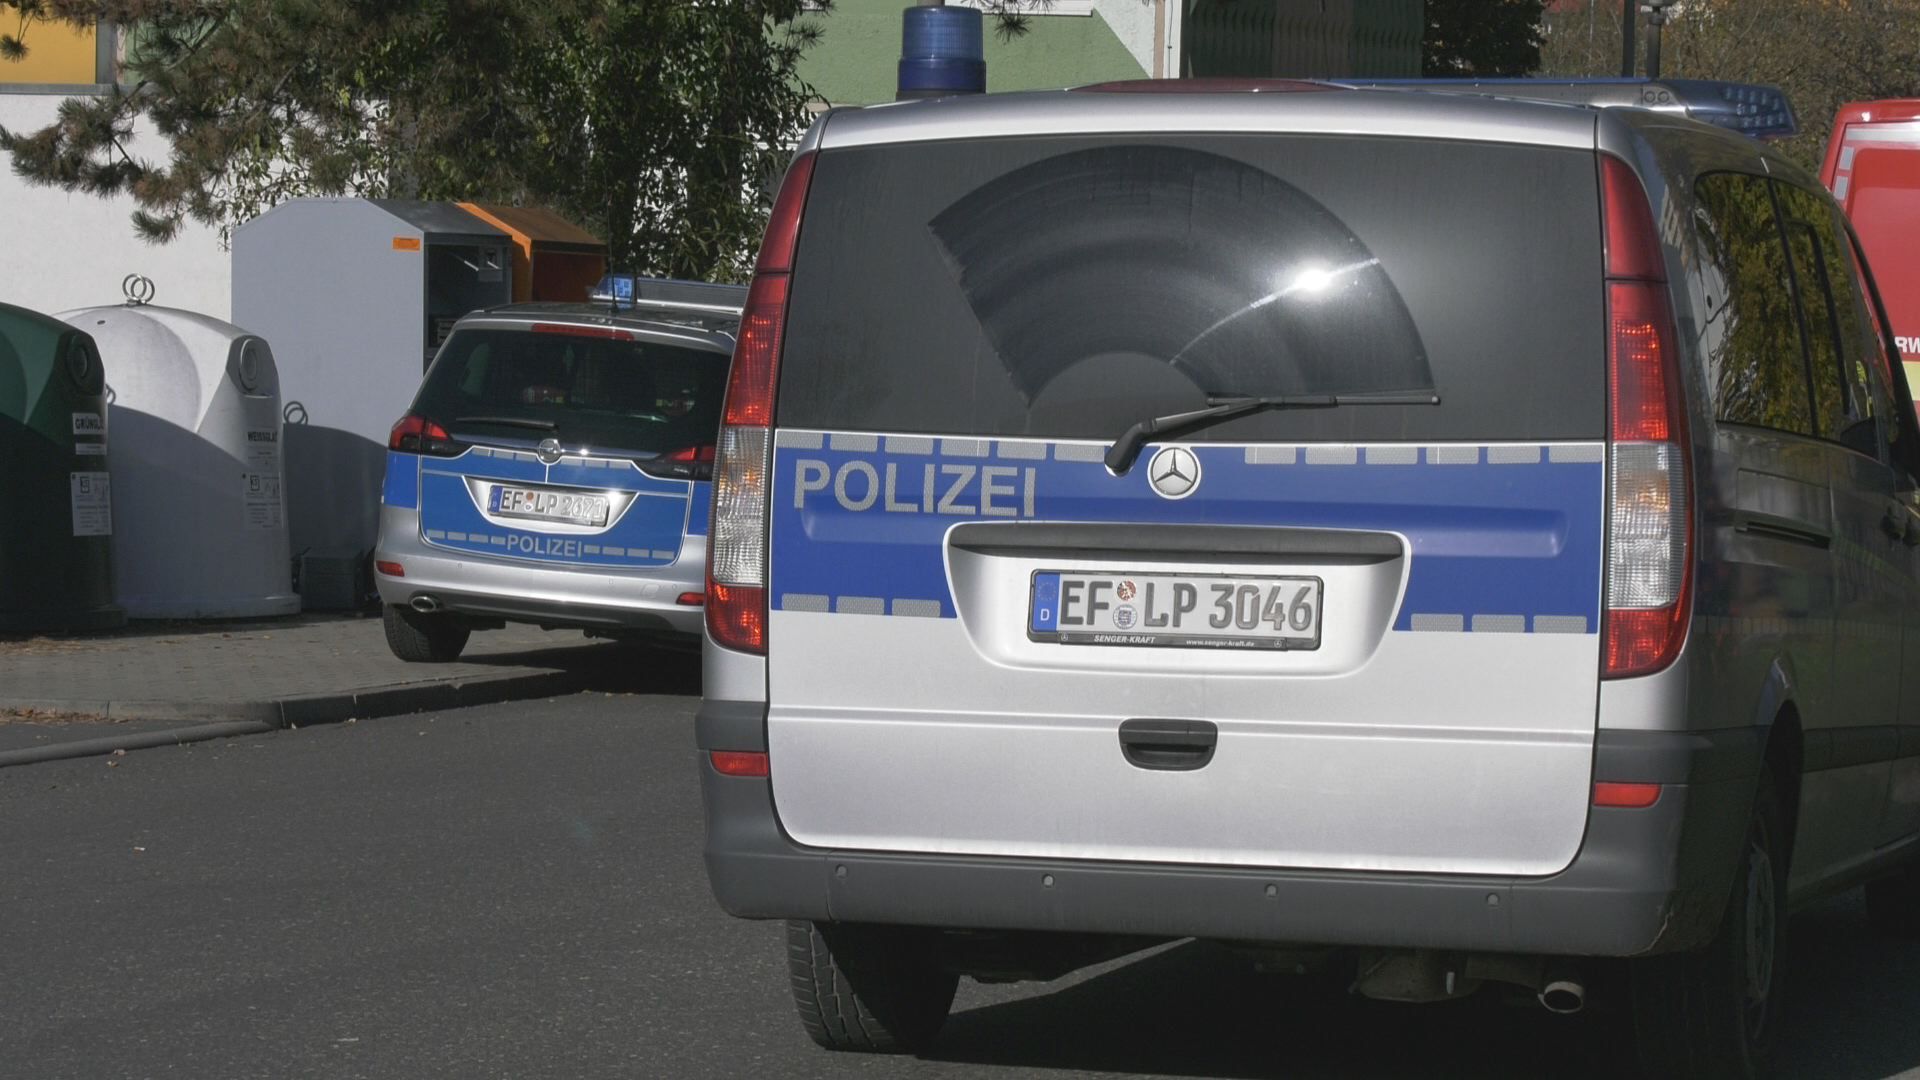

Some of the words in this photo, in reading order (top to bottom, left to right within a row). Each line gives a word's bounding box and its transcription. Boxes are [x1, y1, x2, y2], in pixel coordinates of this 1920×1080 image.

[794, 459, 1036, 518] POLIZEI
[501, 490, 524, 510] EF
[534, 493, 558, 514] LP
[507, 534, 582, 558] POLIZEI
[1040, 608, 1050, 621] D
[1060, 580, 1113, 626] EF
[1143, 582, 1197, 628] LP
[1208, 583, 1312, 631] 3046
[1094, 634, 1156, 644] SENGER-KRAFT
[1186, 639, 1255, 648] www.senger-kraft.de
